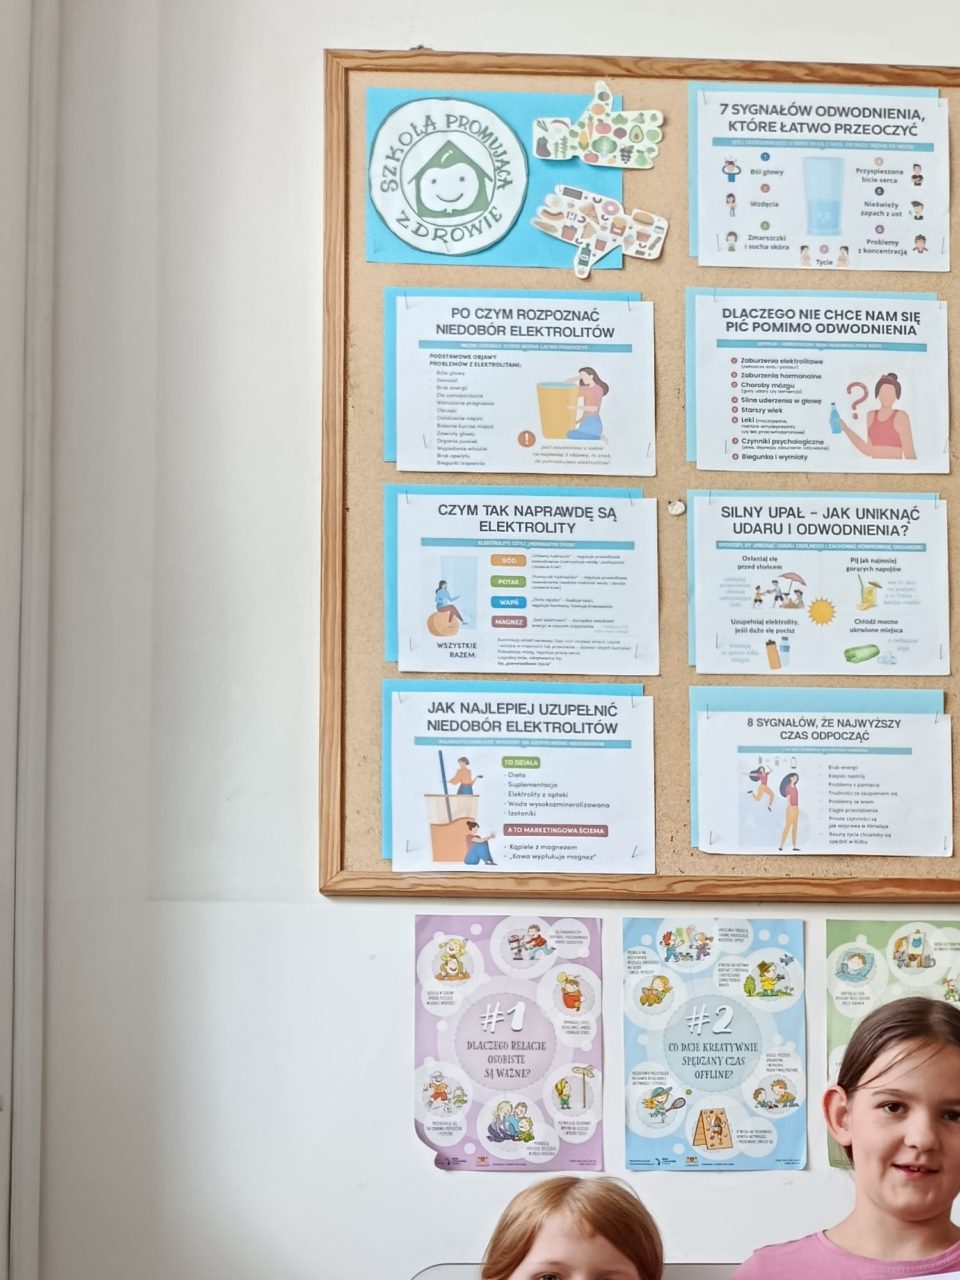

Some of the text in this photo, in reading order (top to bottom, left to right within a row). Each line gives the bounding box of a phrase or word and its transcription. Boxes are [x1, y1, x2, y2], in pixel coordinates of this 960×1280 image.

[720, 102, 925, 122] 7 SYGNAŁÓW ODWODNIENIA,
[728, 119, 918, 136] KTÓRE ŁATWO PRZEOCZYĆ
[380, 113, 514, 193] SZKOŁA PROMUJĄCA
[395, 205, 503, 244] ZDROWIE
[866, 239, 899, 248] Problemy
[452, 308, 600, 322] PO CZYM ROZPOZNAĆ
[722, 308, 920, 325] DLACZEGO NIE CHCE NAM SIĘ
[436, 323, 615, 338] NIEDOBÓR ELEKTROLITÓW
[726, 320, 917, 336] PIĆ POMIMO ODWODNIENIA
[741, 382, 795, 391] Choroby mózgu
[741, 406, 771, 414] Starszy
[742, 453, 808, 462] Biegunka wymioty
[438, 504, 617, 522] CZYM TAK NAPRAWDĘ SĄ
[721, 505, 920, 524] SILNY UPAŁ JAK UNIKNĄĆ
[479, 521, 576, 534] ELEKTROLITY
[733, 523, 909, 537] UDARU ODWODNIENIA?
[738, 563, 757, 571] przed
[495, 618, 523, 626] MAGNEZ
[428, 702, 618, 717] JAK NAJLEPIEJ UZUPEŁNIĆ
[427, 718, 618, 734] NIEDOBÓR ELEKTROLITÓW
[748, 716, 901, 729] 8 SYGNAŁÓW, ŻE NAJWYŻSZY
[780, 730, 869, 743] CZAS ODPOCZĄĆ
[480, 1001, 527, 1034] #1
[685, 1004, 735, 1036] #2
[467, 1040, 546, 1051] DLACZEGO RELACJE
[668, 1042, 759, 1052] CO DAJE KREATYWNIE
[488, 1054, 526, 1065] OSOBISTE
[682, 1057, 745, 1068] SPĘDZANY CZAS
[484, 1067, 531, 1081] SĄ WAŻNE?
[694, 1069, 733, 1079] OFFLINE?
